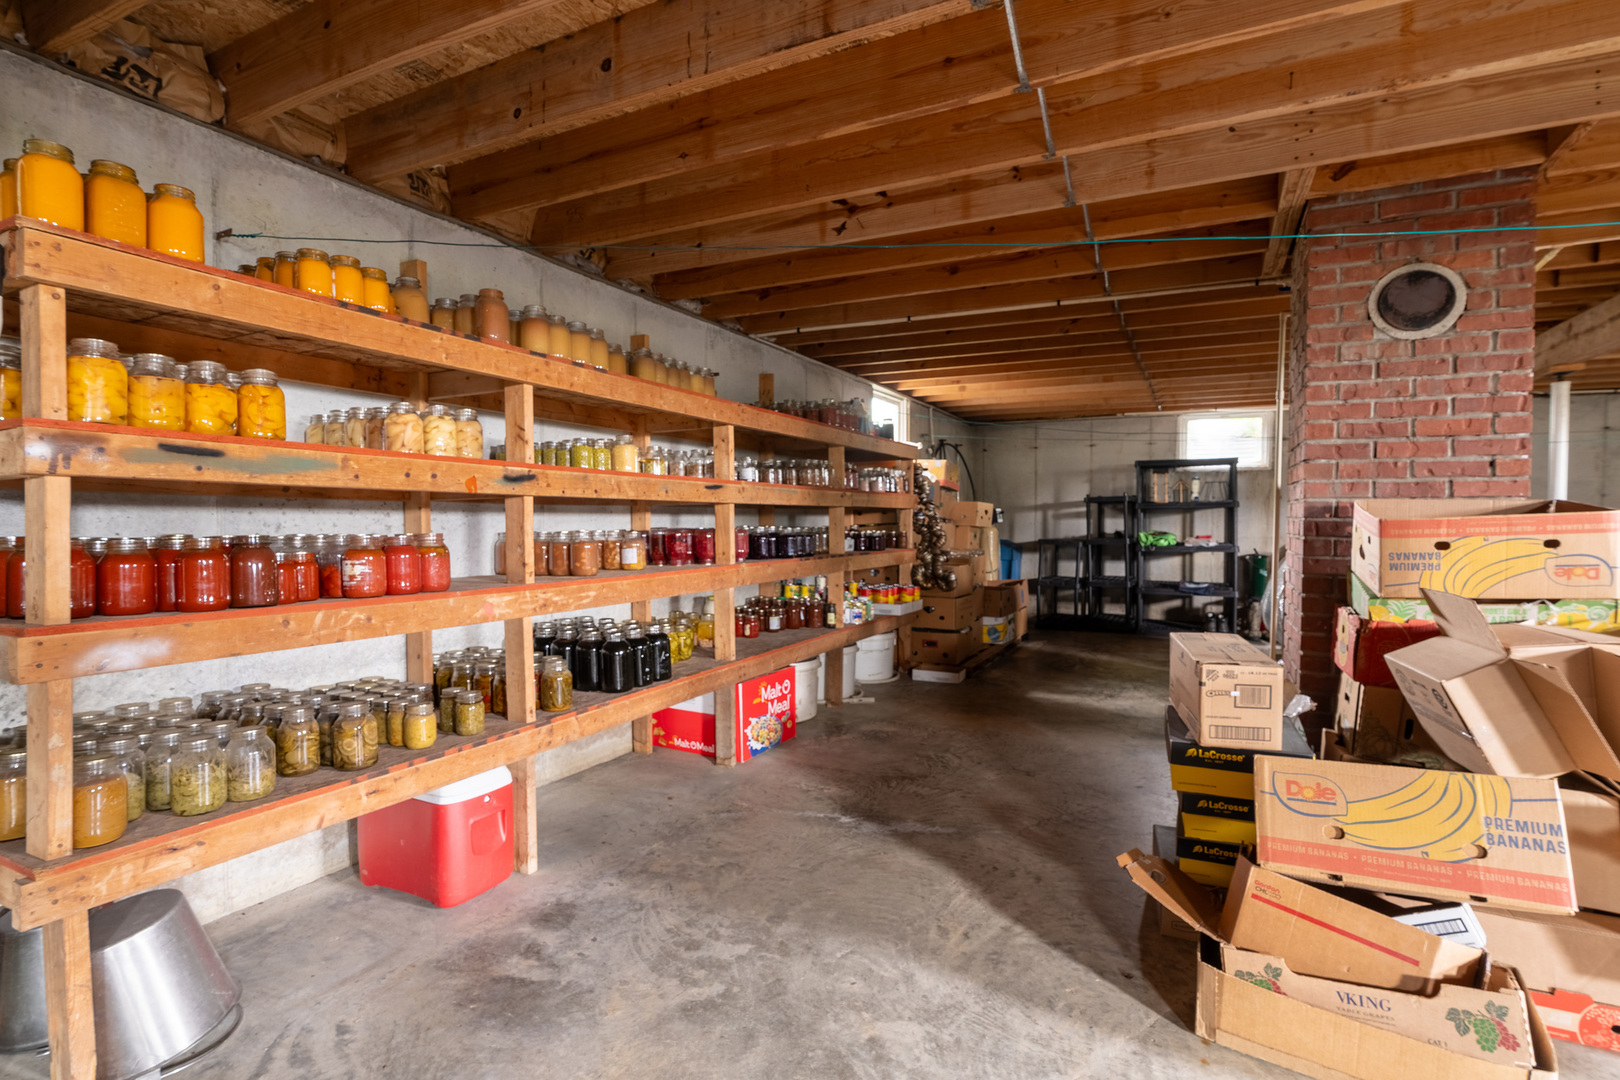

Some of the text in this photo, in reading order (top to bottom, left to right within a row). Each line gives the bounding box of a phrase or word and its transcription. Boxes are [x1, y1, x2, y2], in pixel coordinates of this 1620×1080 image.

[1388, 551, 1441, 561] BANANAS
[1389, 562, 1441, 571] PREMIUM
[1553, 566, 1600, 581] Dole
[768, 694, 791, 716] Meal
[1198, 748, 1243, 762] LaCrosse
[1285, 779, 1337, 801] Dole
[1208, 800, 1249, 812] LaCrosse
[1484, 816, 1563, 837] PREMIUM
[1486, 832, 1566, 854] BANANAS
[1203, 846, 1240, 858] LaCross
[1267, 841, 1309, 854] PREMIUM
[1309, 847, 1349, 860] BANANAS
[1361, 854, 1404, 869] PREMIUM
[1406, 860, 1453, 876] BANANAS
[1466, 869, 1515, 885] PREMIUM
[1517, 878, 1569, 892] BANANAS
